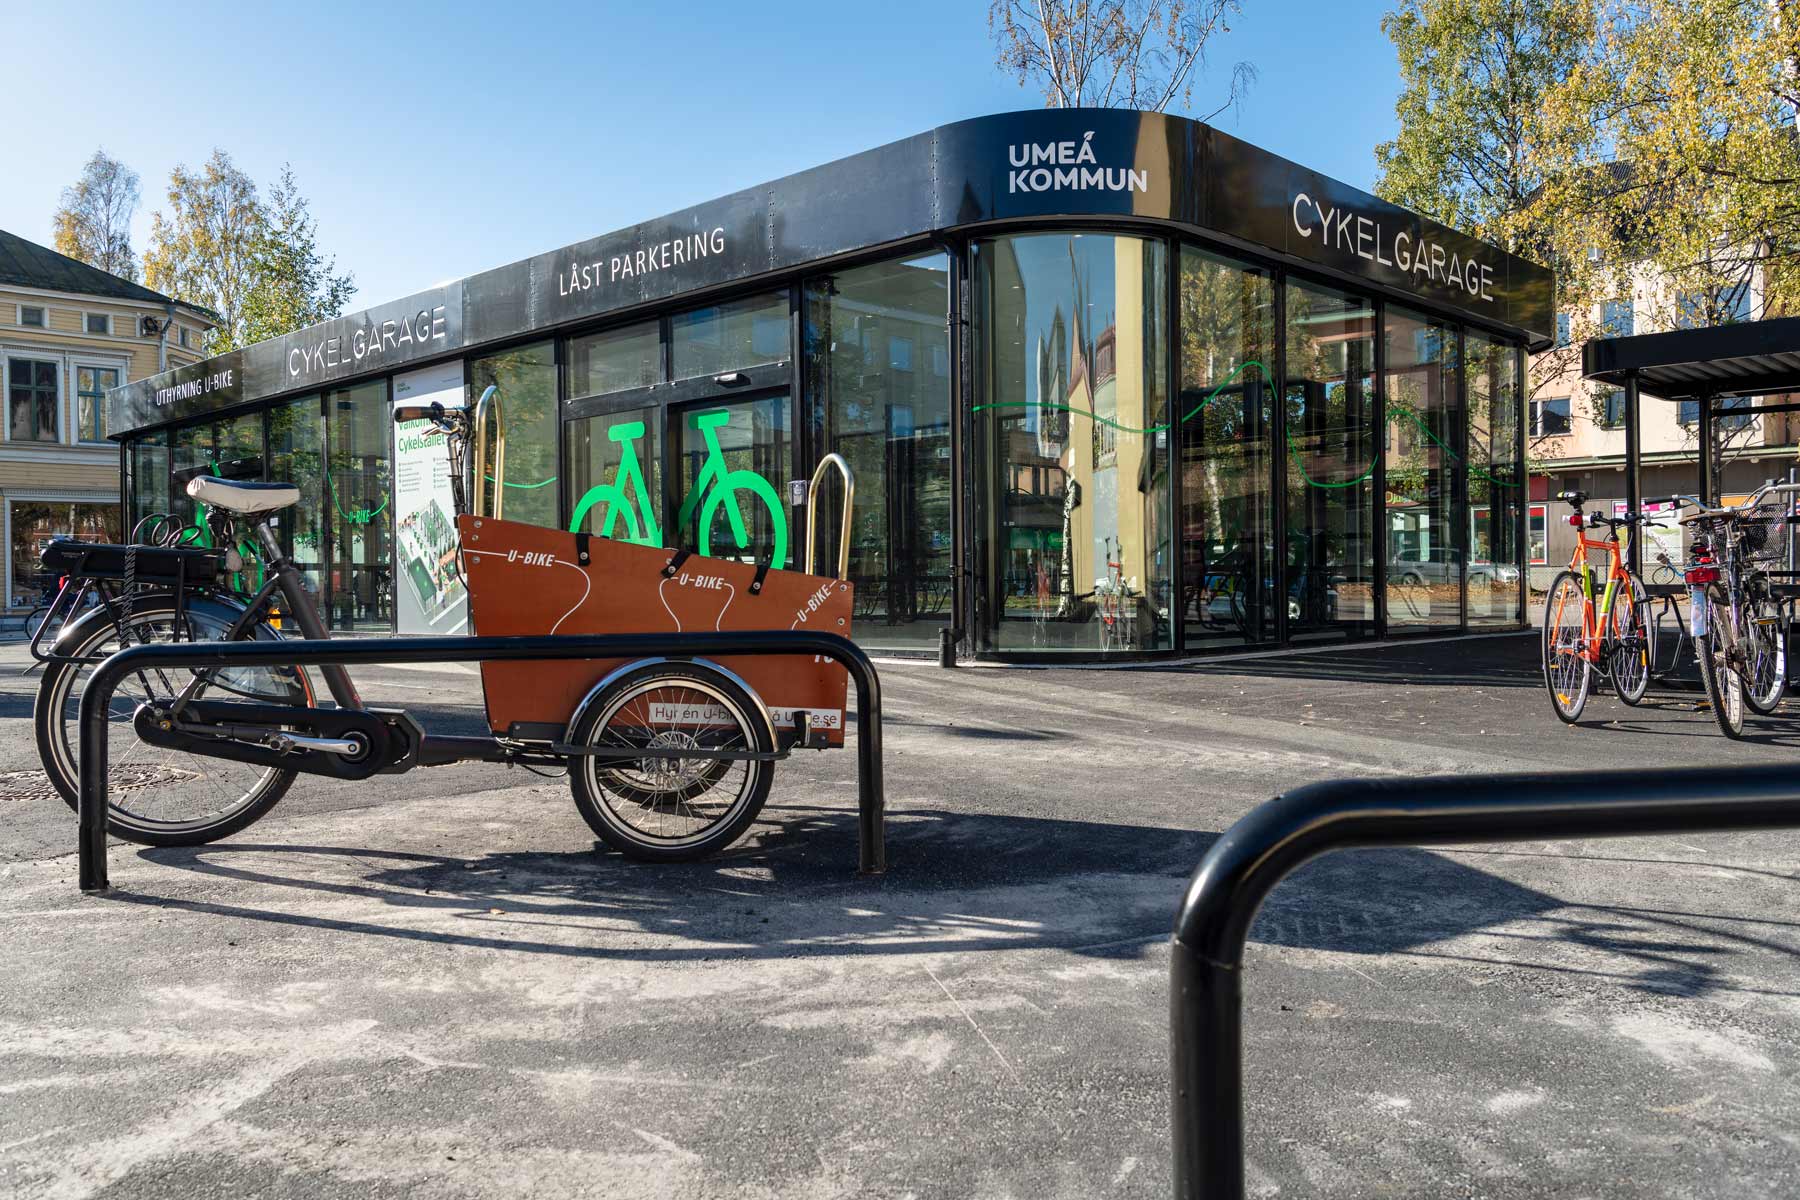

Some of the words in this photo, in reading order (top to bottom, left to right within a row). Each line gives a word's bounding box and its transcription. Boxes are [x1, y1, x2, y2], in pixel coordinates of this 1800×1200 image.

[1008, 130, 1097, 168] UMEÅ
[1008, 167, 1148, 194] KOMMUN
[559, 262, 604, 297] LÅST
[611, 227, 725, 283] PARKERING
[1293, 193, 1494, 302] CYKELGARAGE
[288, 305, 446, 377] CYKELGARAGE
[156, 379, 202, 406] UTHYRNING
[204, 369, 233, 393] U-BIKE
[507, 550, 556, 567] U-BIKE
[679, 573, 725, 590] U-BIKE
[796, 584, 832, 623] U-BIKE
[655, 707, 678, 720] Hyr
